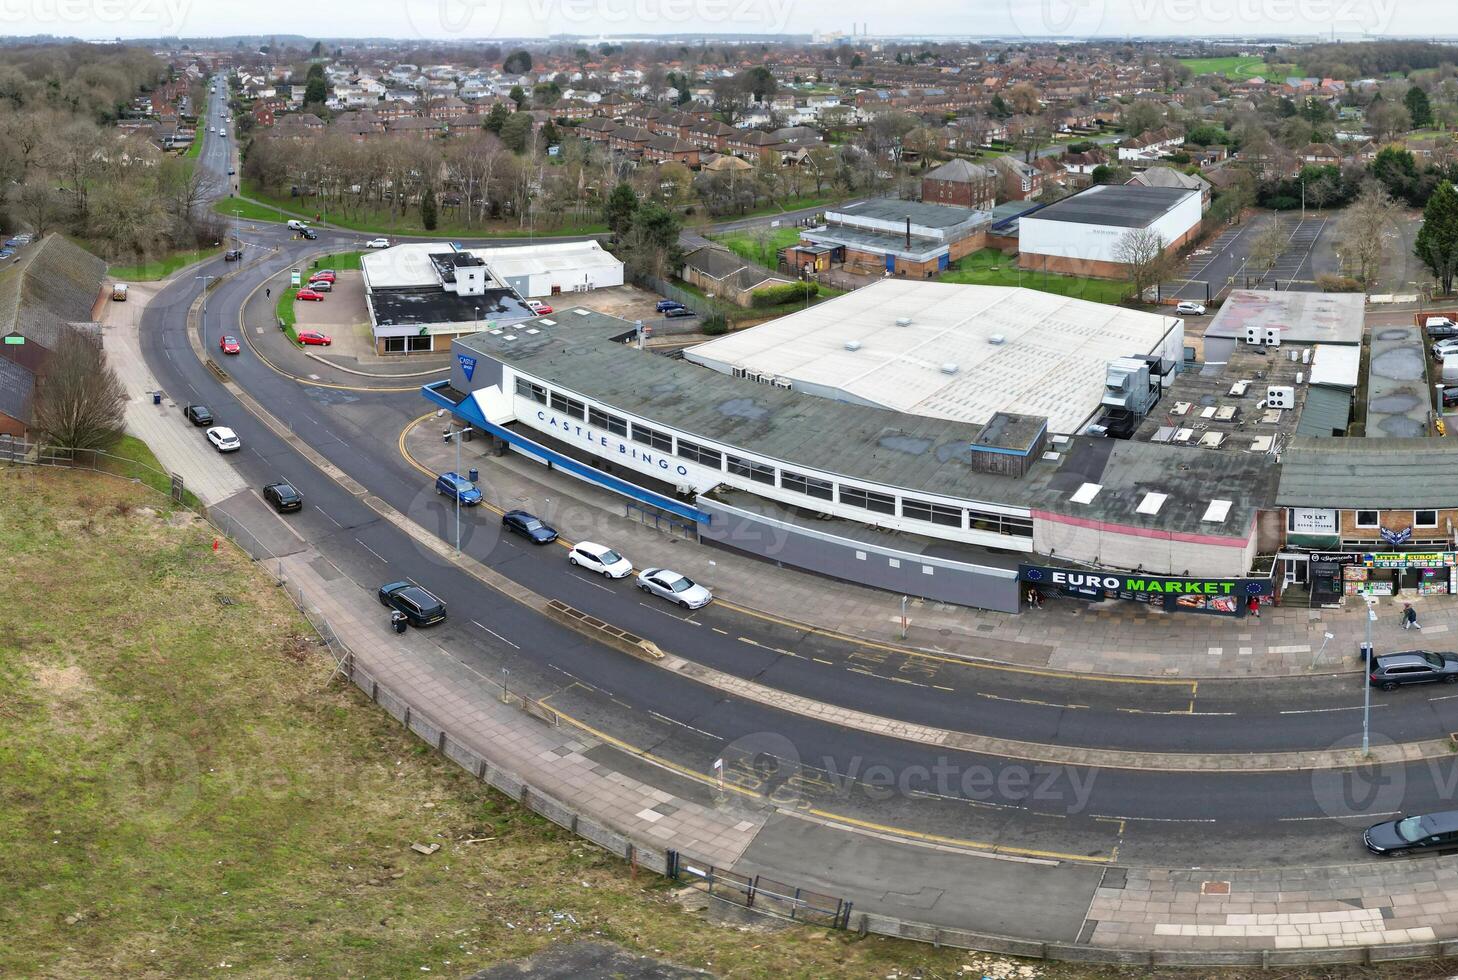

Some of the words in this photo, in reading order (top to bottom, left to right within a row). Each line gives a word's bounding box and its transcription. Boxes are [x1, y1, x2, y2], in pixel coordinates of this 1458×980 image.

[459, 356, 475, 365] CASTLE
[537, 411, 607, 447] CASTLE
[619, 444, 688, 476] BINGO
[1052, 571, 1120, 589] EURO
[1126, 578, 1235, 594] MARKET
